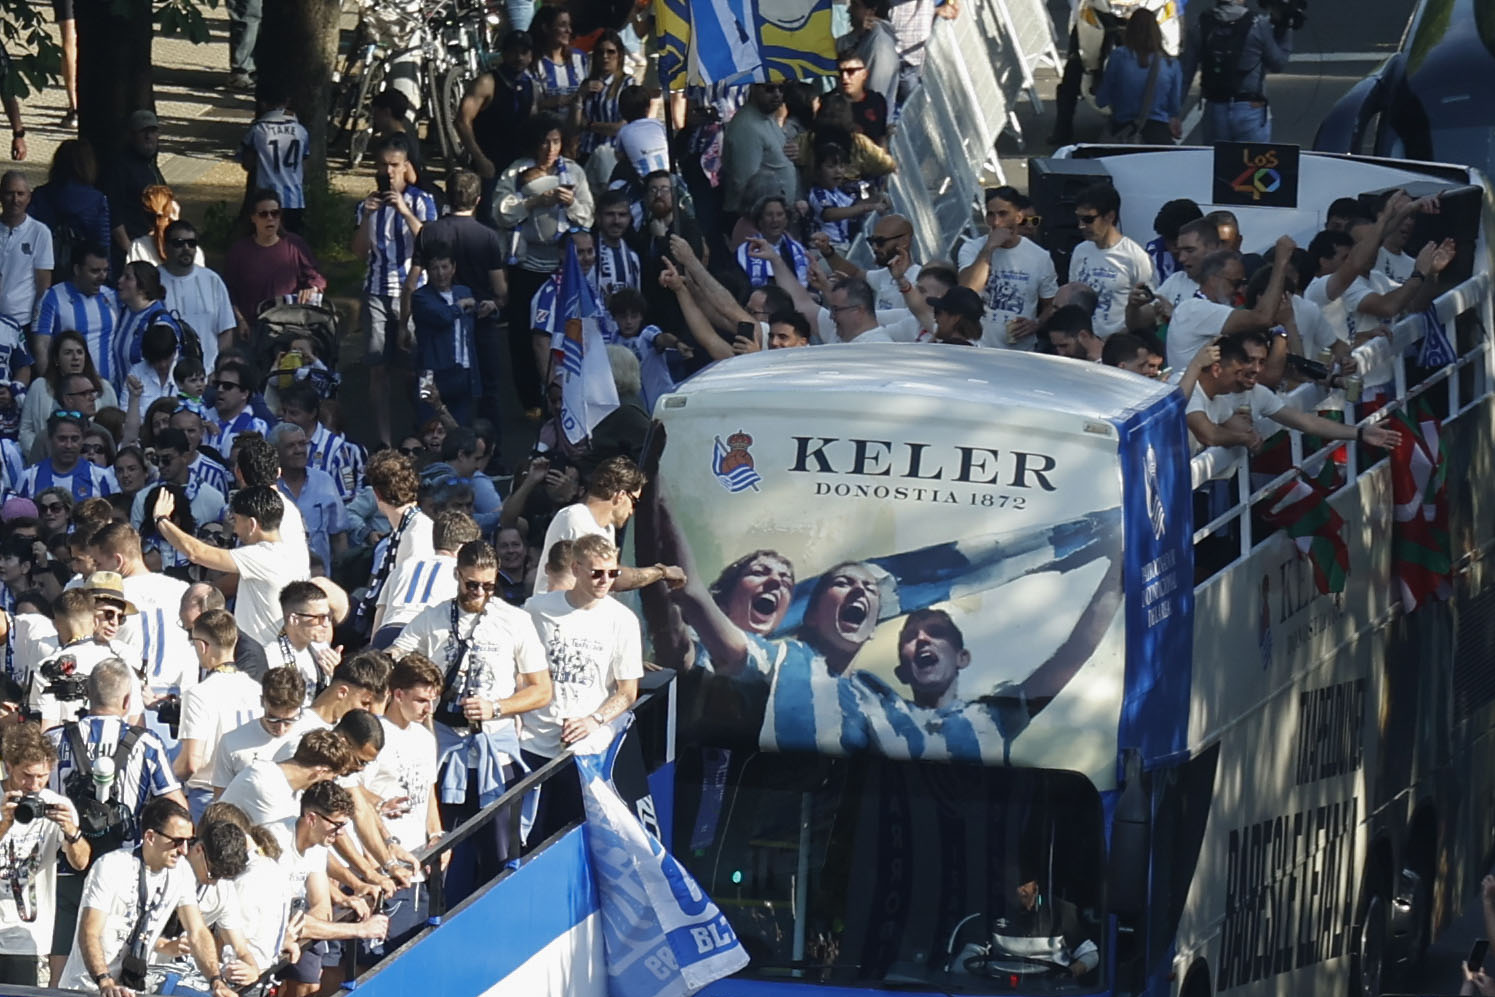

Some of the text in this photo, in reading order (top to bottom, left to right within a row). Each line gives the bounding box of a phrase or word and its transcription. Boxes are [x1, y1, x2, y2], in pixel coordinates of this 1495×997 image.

[268, 139, 301, 174] 14
[1231, 167, 1281, 200] 40
[787, 436, 1058, 493] KELER
[814, 482, 1027, 511] DONOSTIA 1872
